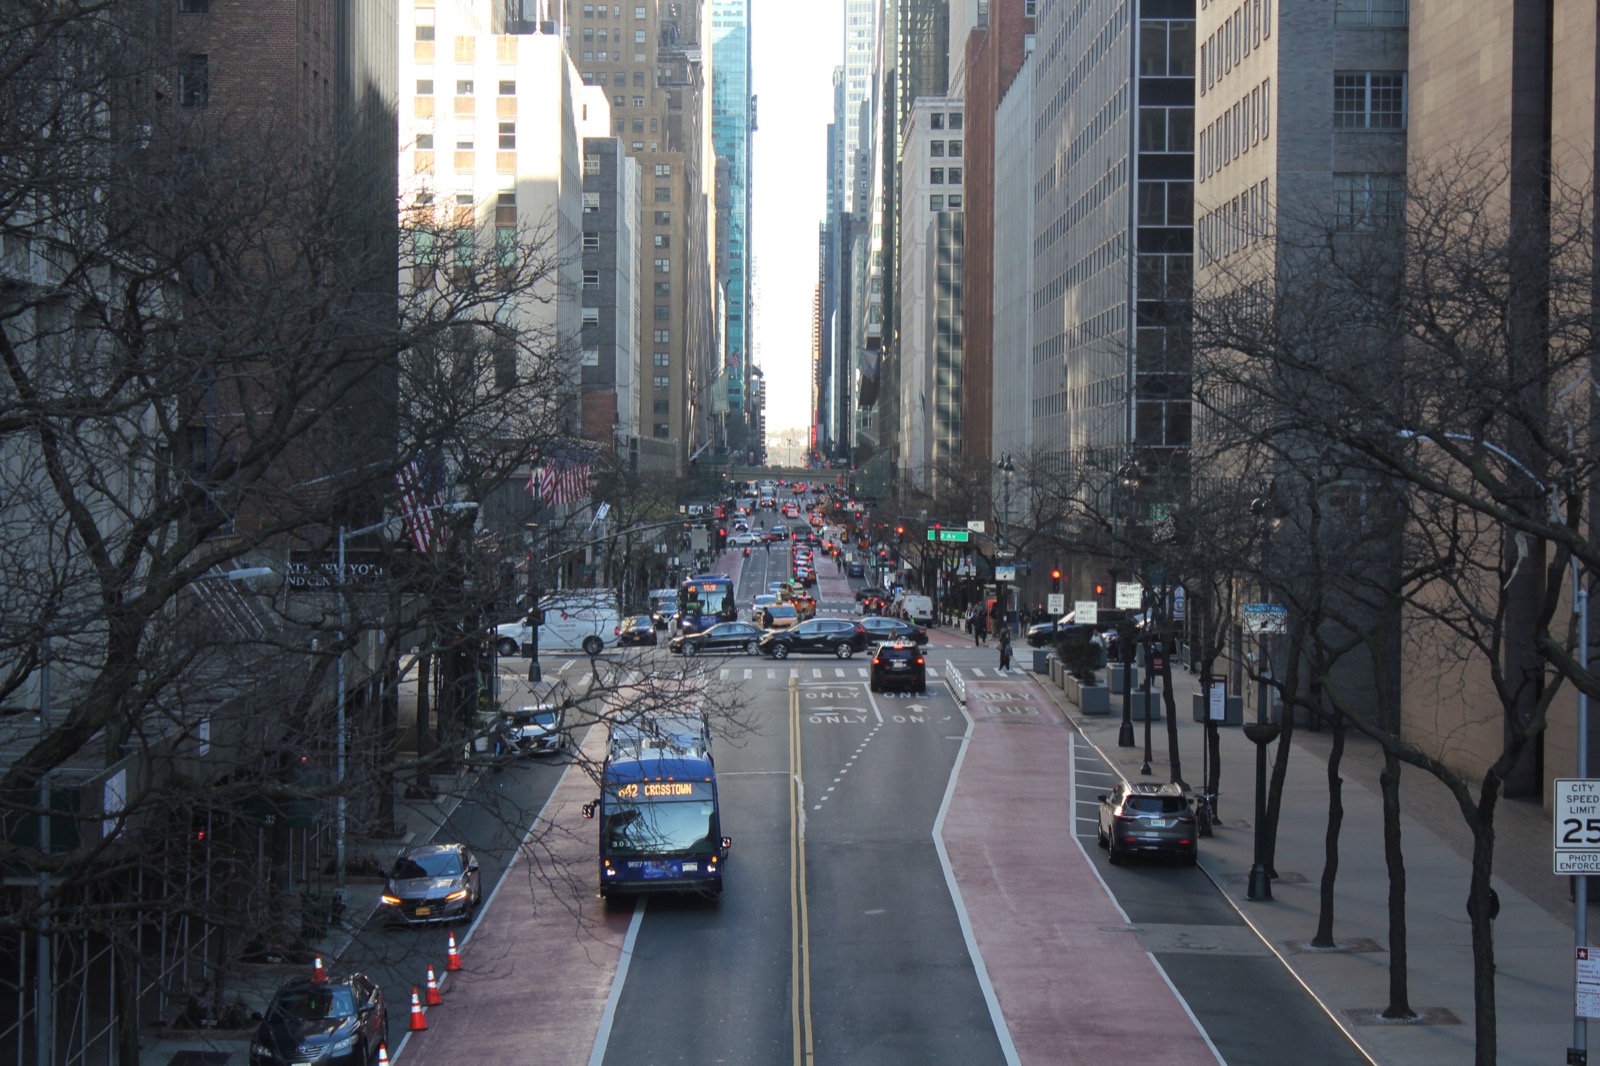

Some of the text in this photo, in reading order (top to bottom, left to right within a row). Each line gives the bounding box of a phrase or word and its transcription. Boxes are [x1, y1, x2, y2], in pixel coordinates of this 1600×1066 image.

[986, 706, 1040, 715] BUS
[808, 715, 868, 724] ONLY
[644, 783, 693, 796] CROSSTOWN
[1571, 784, 1595, 792] CITY
[1566, 795, 1599, 803] SPEED
[1570, 806, 1596, 814] LIMIT
[1563, 818, 1600, 843] 25
[1569, 854, 1598, 862] PHOTO
